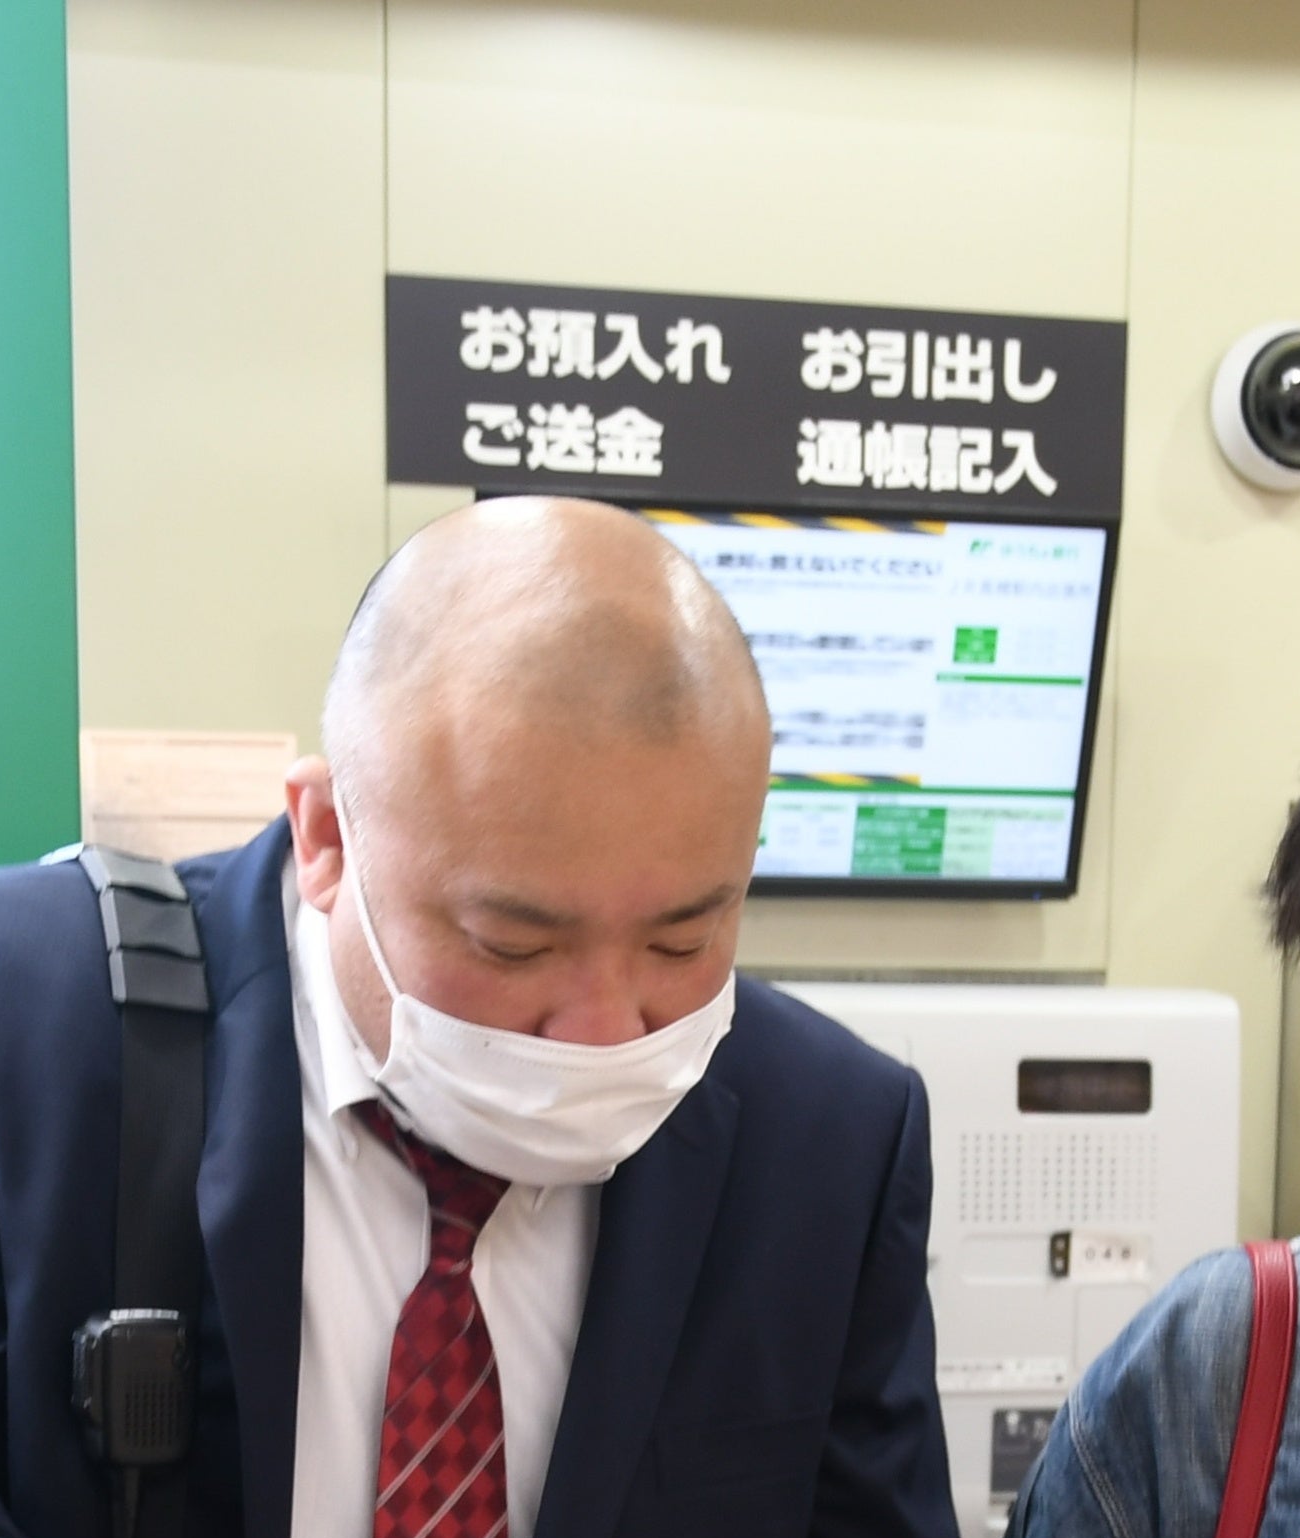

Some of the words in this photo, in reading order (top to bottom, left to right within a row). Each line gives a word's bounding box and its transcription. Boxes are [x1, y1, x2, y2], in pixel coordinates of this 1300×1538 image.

[459, 306, 730, 383] お預入れ
[800, 328, 1057, 403] お引出し
[462, 402, 663, 476] ご送金
[797, 418, 1058, 496] 通帳記入
